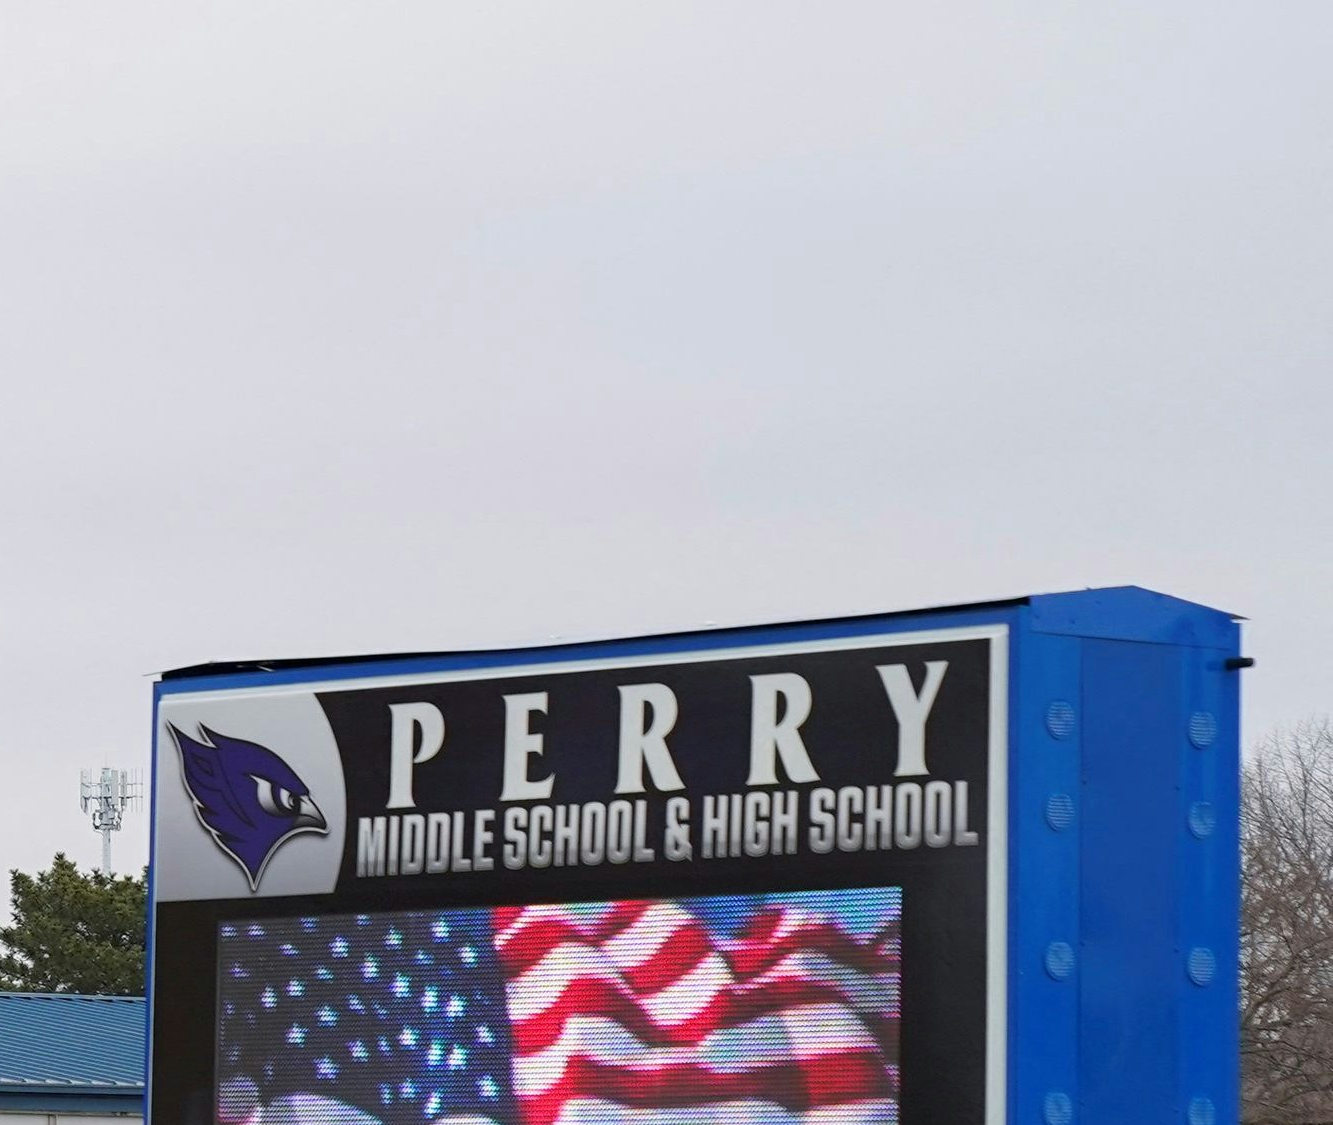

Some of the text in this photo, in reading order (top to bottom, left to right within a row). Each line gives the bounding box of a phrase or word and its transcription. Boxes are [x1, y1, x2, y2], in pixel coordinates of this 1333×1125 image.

[385, 660, 950, 809] PERRY
[356, 780, 979, 878] MIDDLE SCHOOL & HIGH SCHOOL
